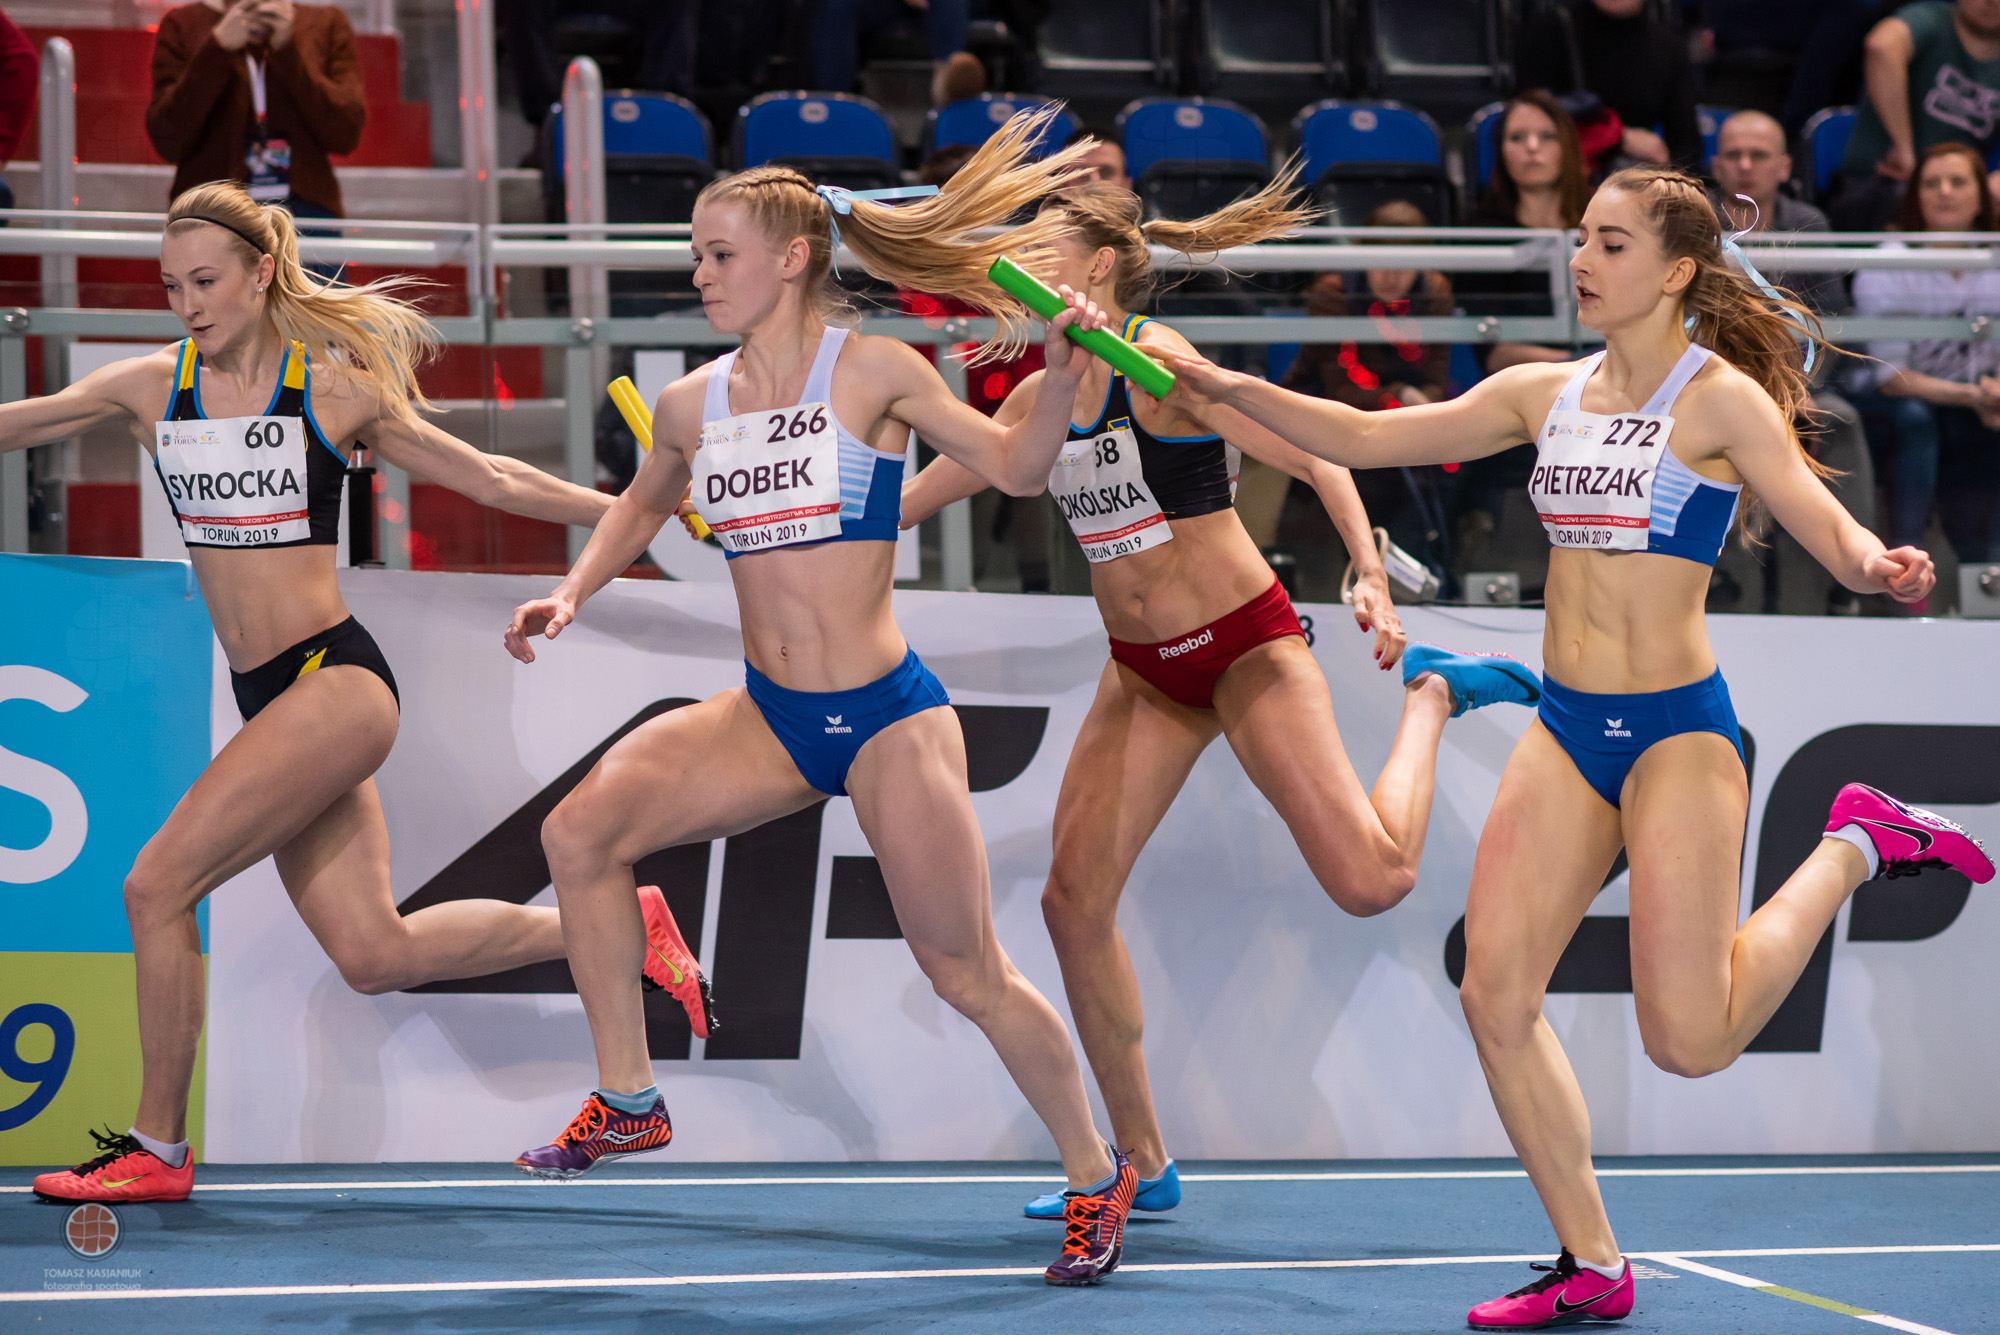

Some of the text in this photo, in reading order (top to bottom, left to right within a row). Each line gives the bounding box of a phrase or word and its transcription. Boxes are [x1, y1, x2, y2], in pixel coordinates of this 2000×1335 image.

[244, 421, 285, 448] 60
[767, 406, 828, 443] 266
[1602, 418, 1661, 447] 272
[169, 468, 301, 501] SYROCKA
[706, 457, 814, 504] DOBEK
[1531, 465, 1650, 499] PIETRZAK
[804, 506, 831, 515] POLSKI
[1055, 481, 1148, 521] OKÓLSKA
[276, 513, 301, 521] POLSKI
[1613, 518, 1640, 526] POLSKI
[202, 527, 279, 543] TORUŃ 2019
[730, 523, 807, 548] TORUŃ 2019
[1591, 530, 1613, 544] 2019
[1084, 536, 1142, 560] ORUŃ 2019
[824, 726, 853, 734] erima
[1604, 729, 1632, 737] erima
[0, 1003, 76, 1132] 9
